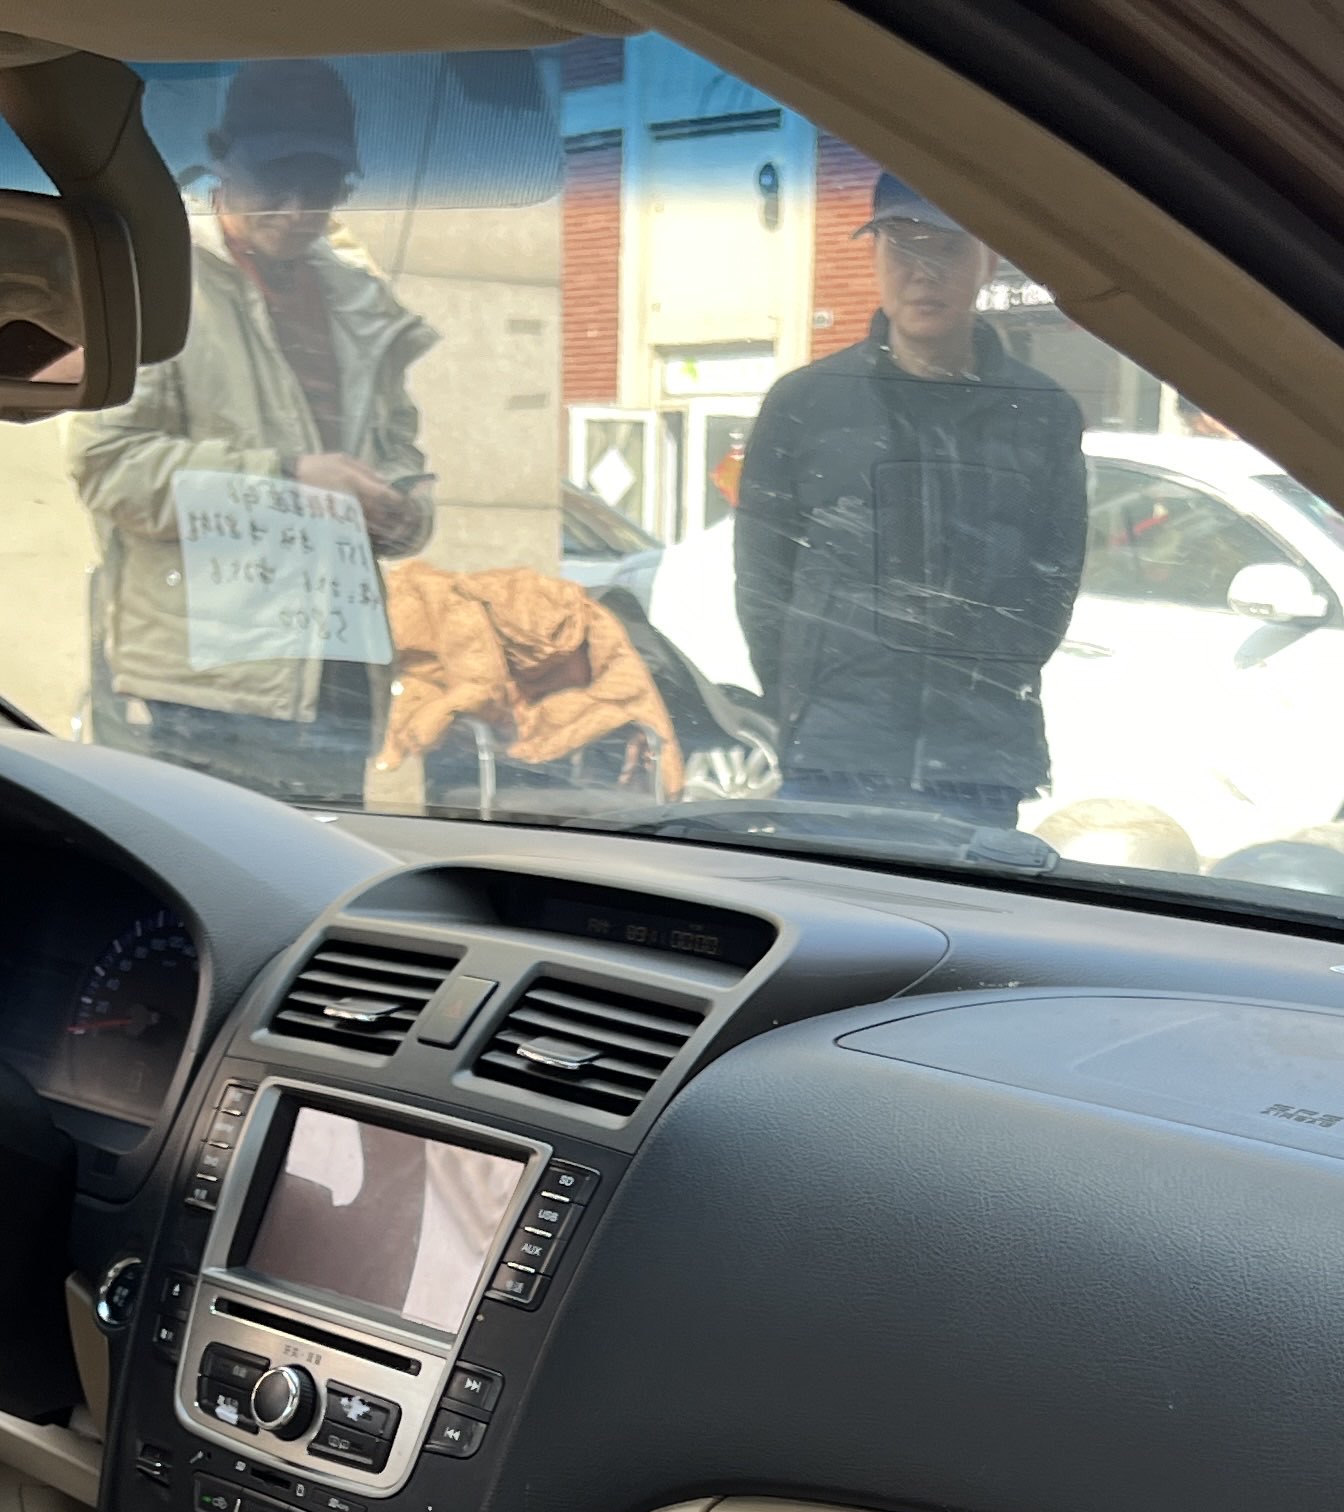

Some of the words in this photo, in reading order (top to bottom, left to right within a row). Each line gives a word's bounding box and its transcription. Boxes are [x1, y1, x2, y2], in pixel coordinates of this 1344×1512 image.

[558, 1174, 575, 1187] SD
[538, 1209, 559, 1223] USB
[521, 1243, 543, 1257] AUX
